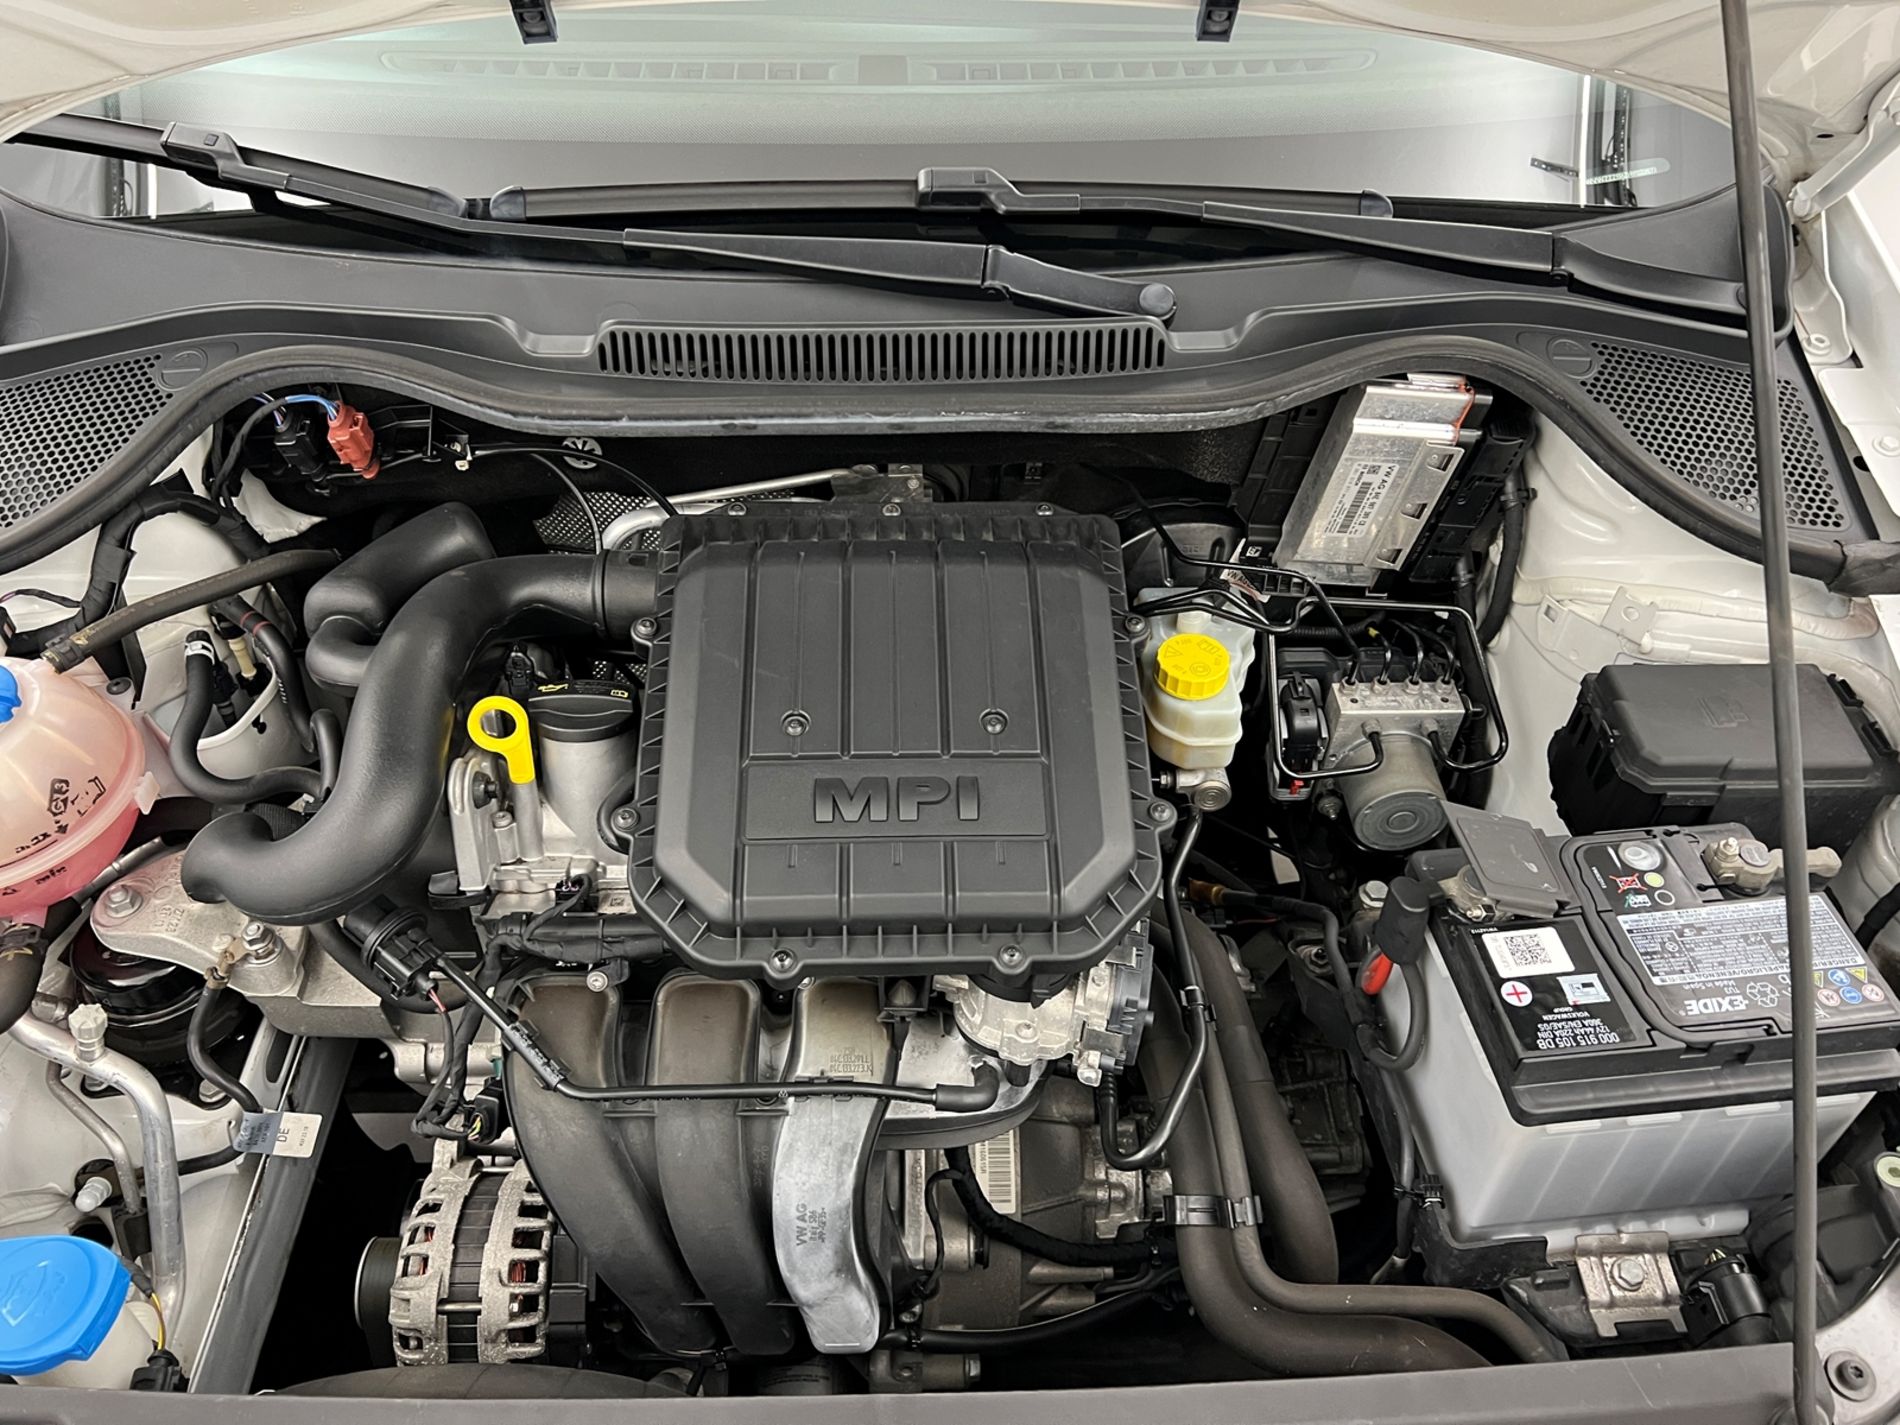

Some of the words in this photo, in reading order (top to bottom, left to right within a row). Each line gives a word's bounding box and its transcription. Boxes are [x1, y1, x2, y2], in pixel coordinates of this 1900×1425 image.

[814, 775, 980, 823] MPI
[1685, 995, 1749, 1016] EXIDE
[1536, 1038, 1556, 1050] DB
[1556, 1036, 1577, 1048] 105
[1577, 1034, 1598, 1046] 915
[1598, 1032, 1620, 1043] 000
[796, 1202, 807, 1223] AG
[796, 1226, 807, 1246] VW
